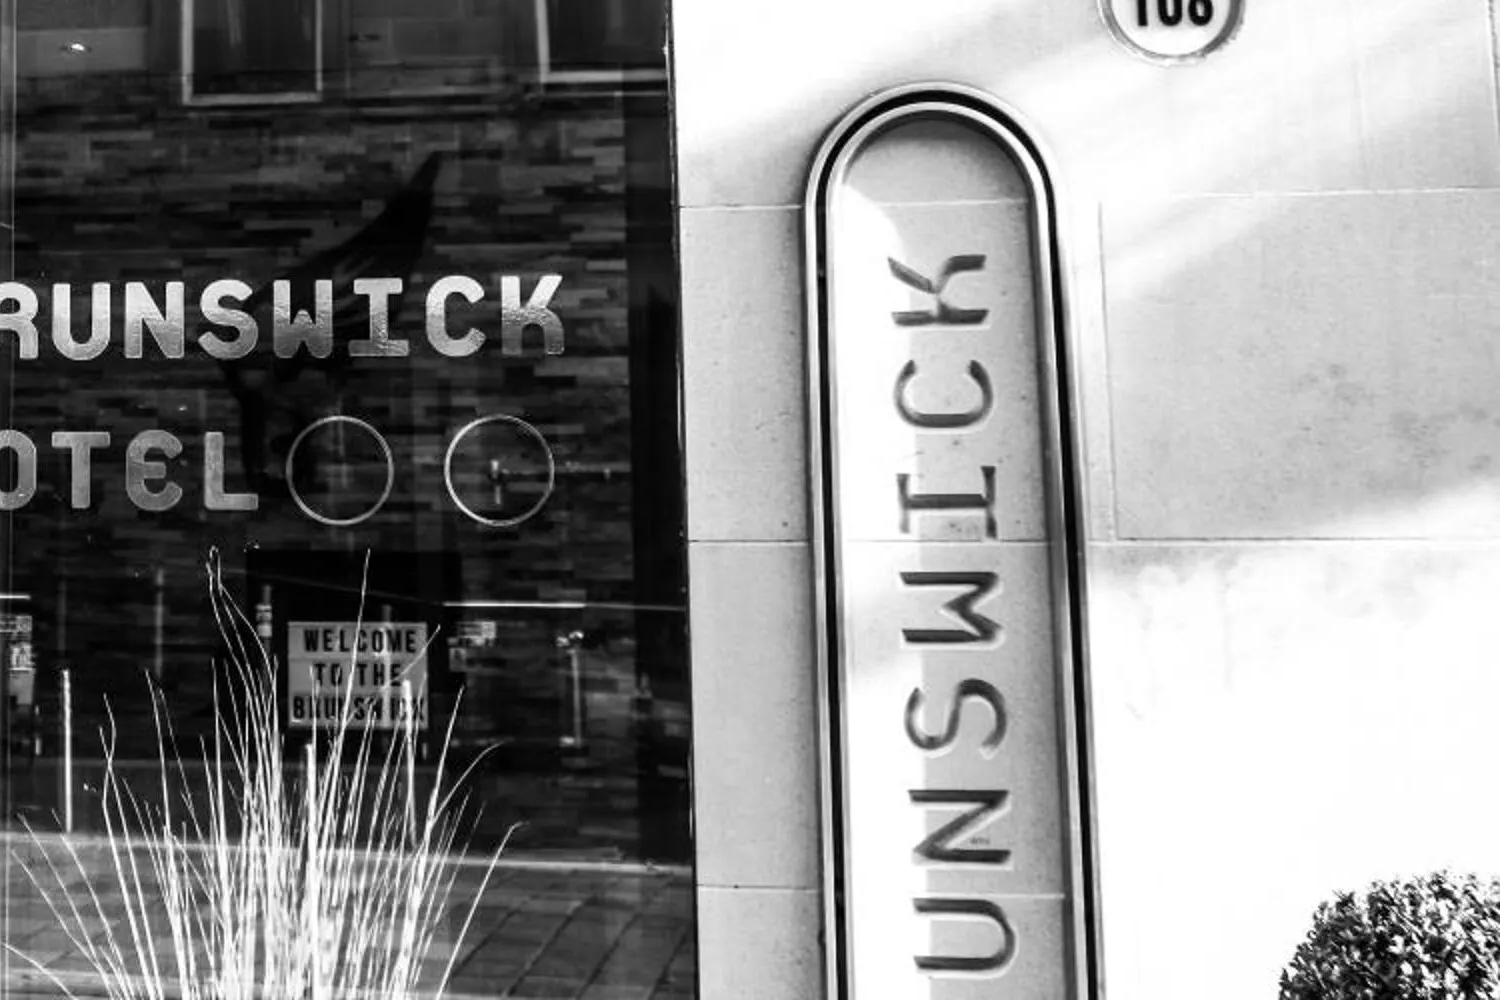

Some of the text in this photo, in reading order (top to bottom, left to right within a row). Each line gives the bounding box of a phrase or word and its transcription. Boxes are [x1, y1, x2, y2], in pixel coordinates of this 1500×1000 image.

[304, 629, 417, 652] WELCOME
[314, 663, 402, 686] TO THE
